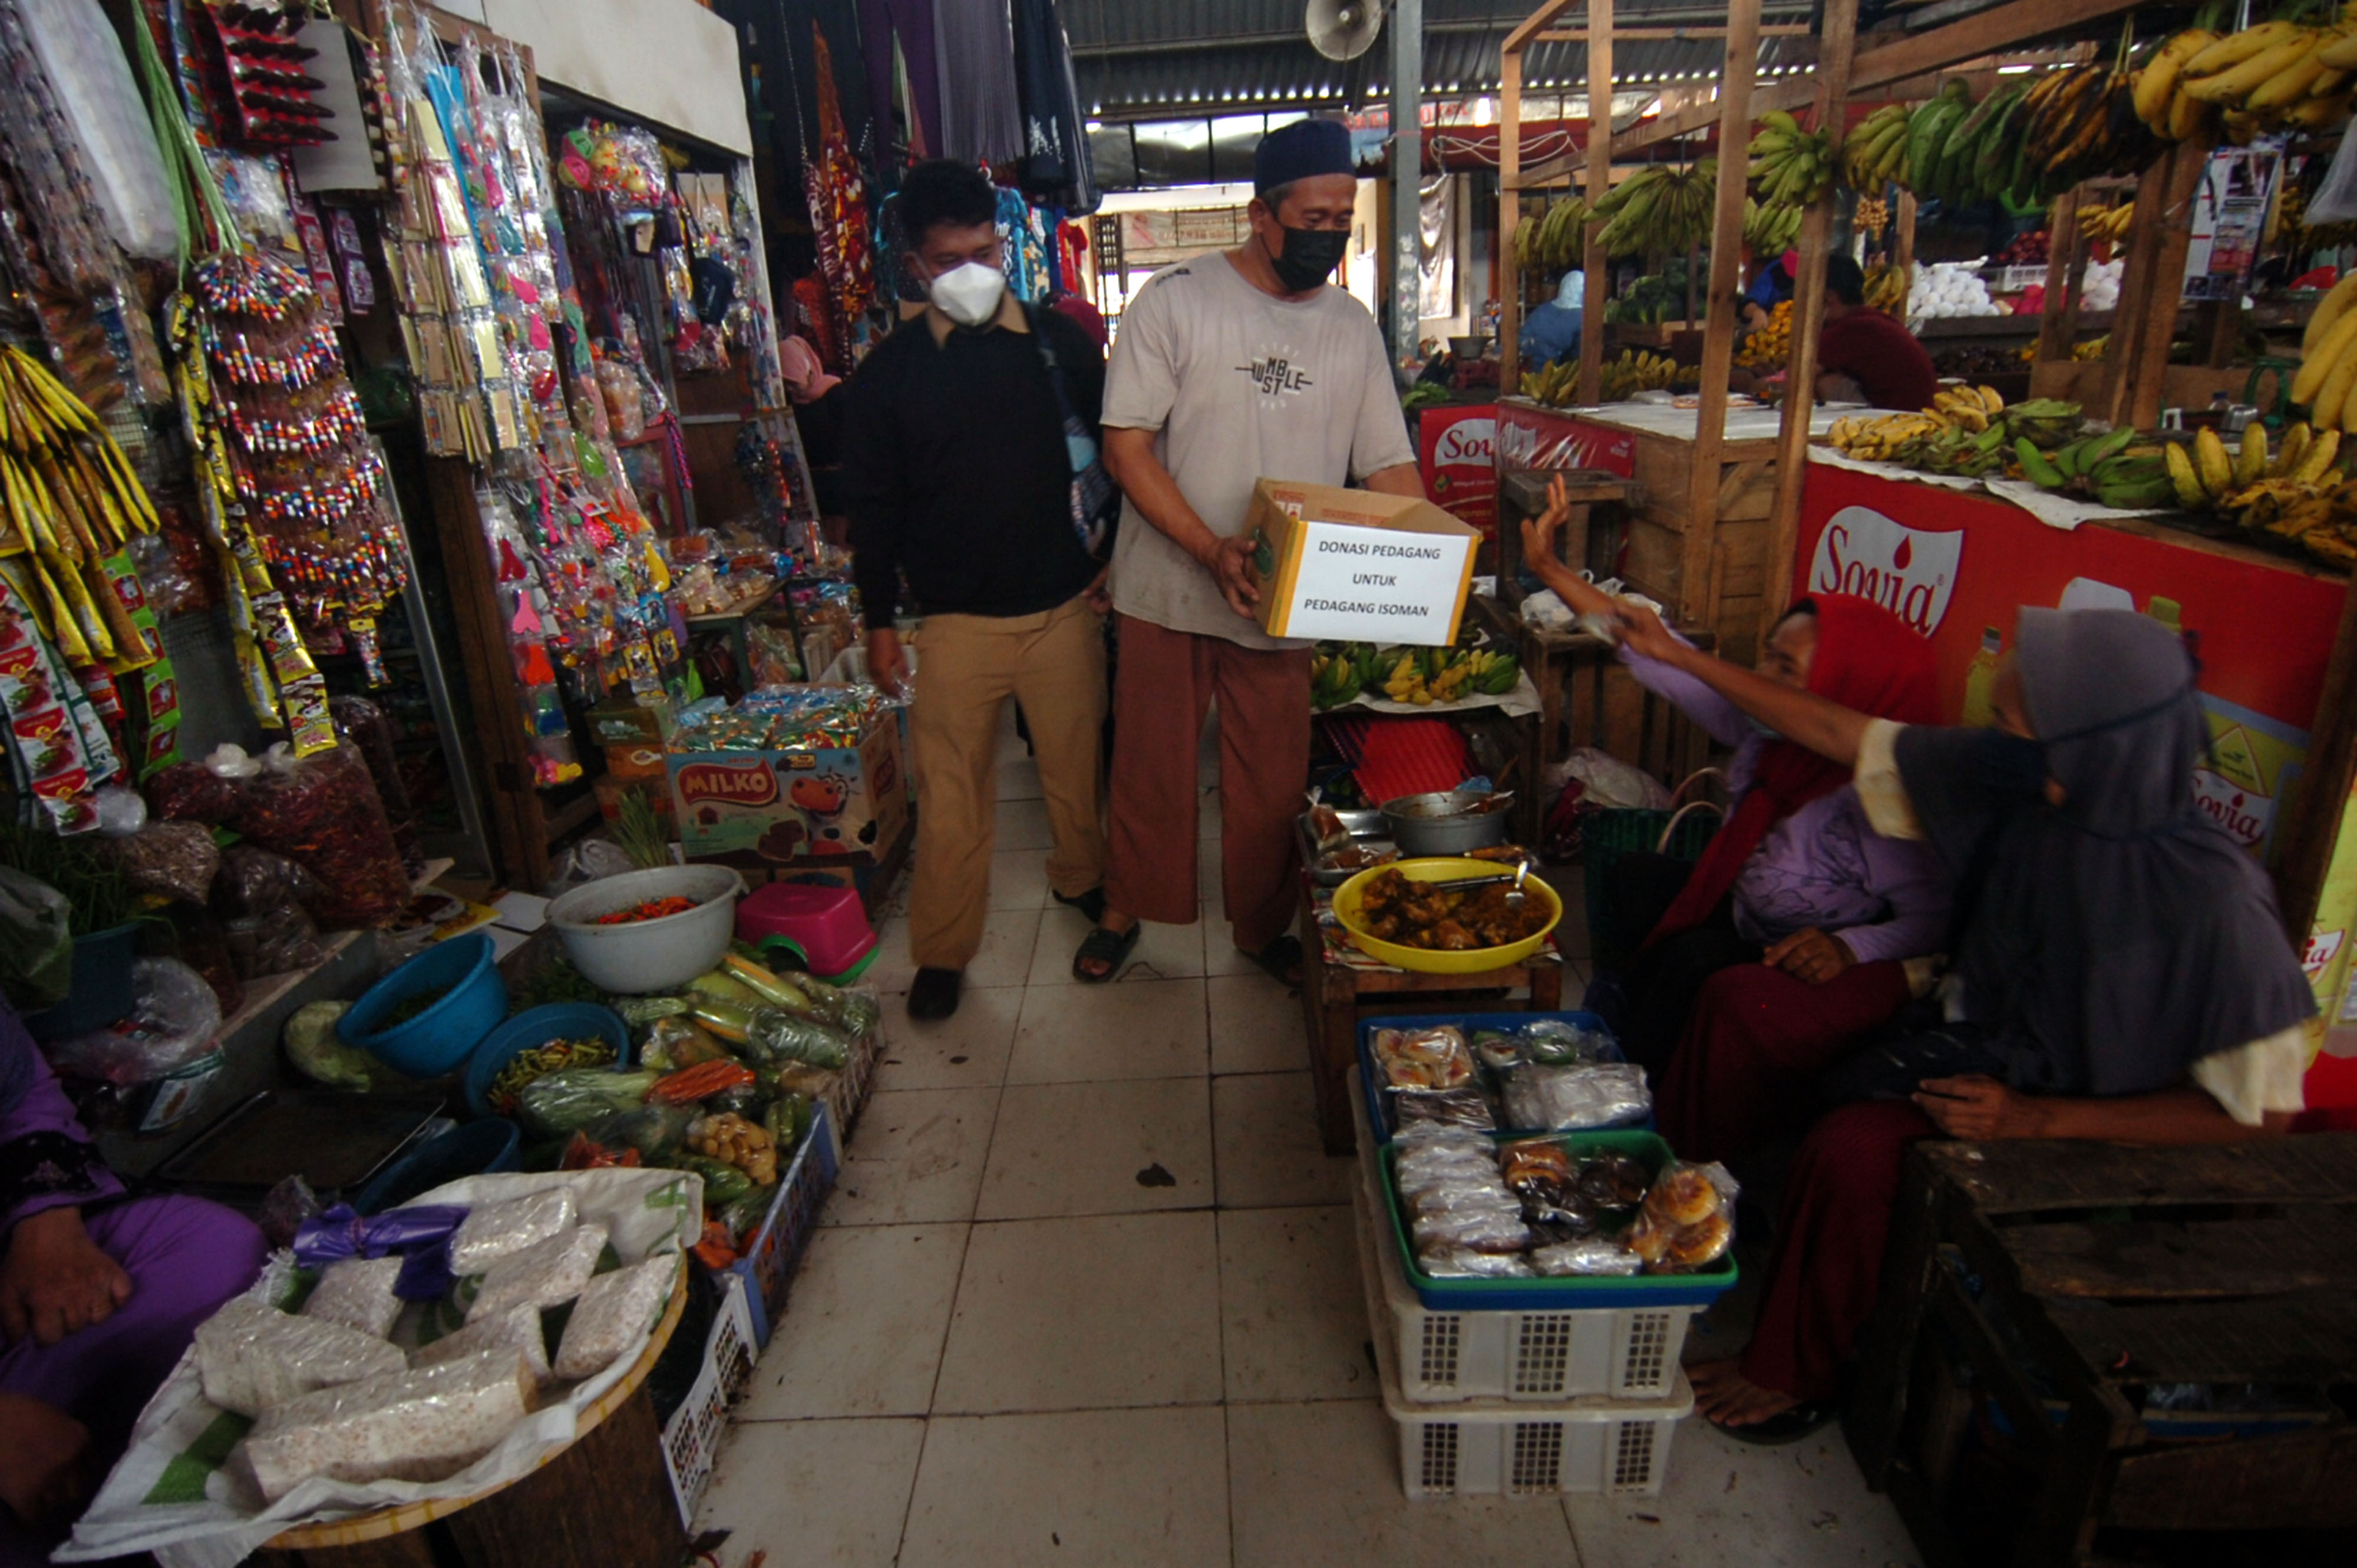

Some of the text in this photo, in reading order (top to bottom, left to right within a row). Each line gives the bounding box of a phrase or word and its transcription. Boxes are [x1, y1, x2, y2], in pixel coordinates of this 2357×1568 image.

[1318, 540, 1441, 559] DONASI PEDAGANG
[1352, 573, 1397, 586] UNTUK
[1820, 524, 1935, 638] Sovia
[1303, 598, 1430, 617] PEDAGANG ISOMAN
[685, 772, 768, 794] MILKO
